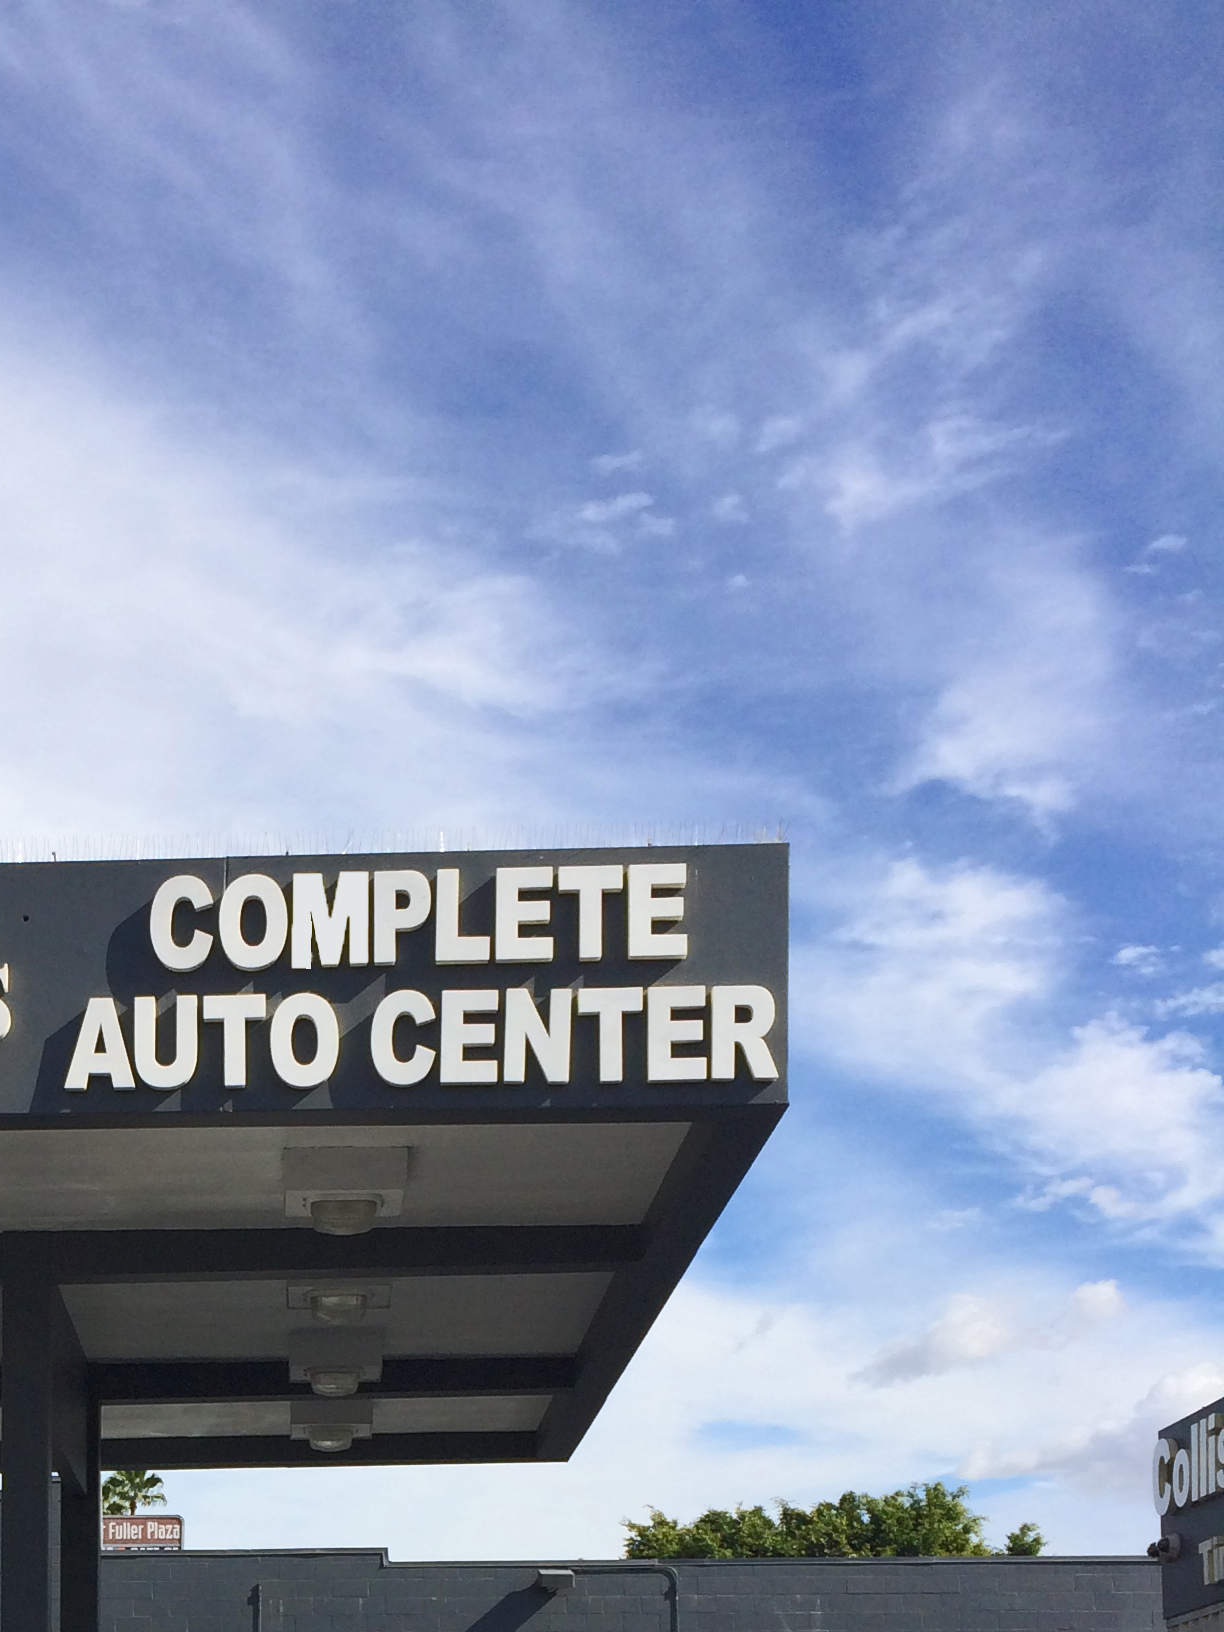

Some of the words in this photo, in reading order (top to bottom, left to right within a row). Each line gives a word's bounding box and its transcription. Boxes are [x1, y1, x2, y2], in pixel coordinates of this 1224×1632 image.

[150, 863, 689, 972] COMPLETE
[64, 992, 341, 1091] AUTO
[370, 984, 779, 1086] CENTER
[109, 1522, 144, 1540] Fuller
[147, 1521, 181, 1540] Plaza
